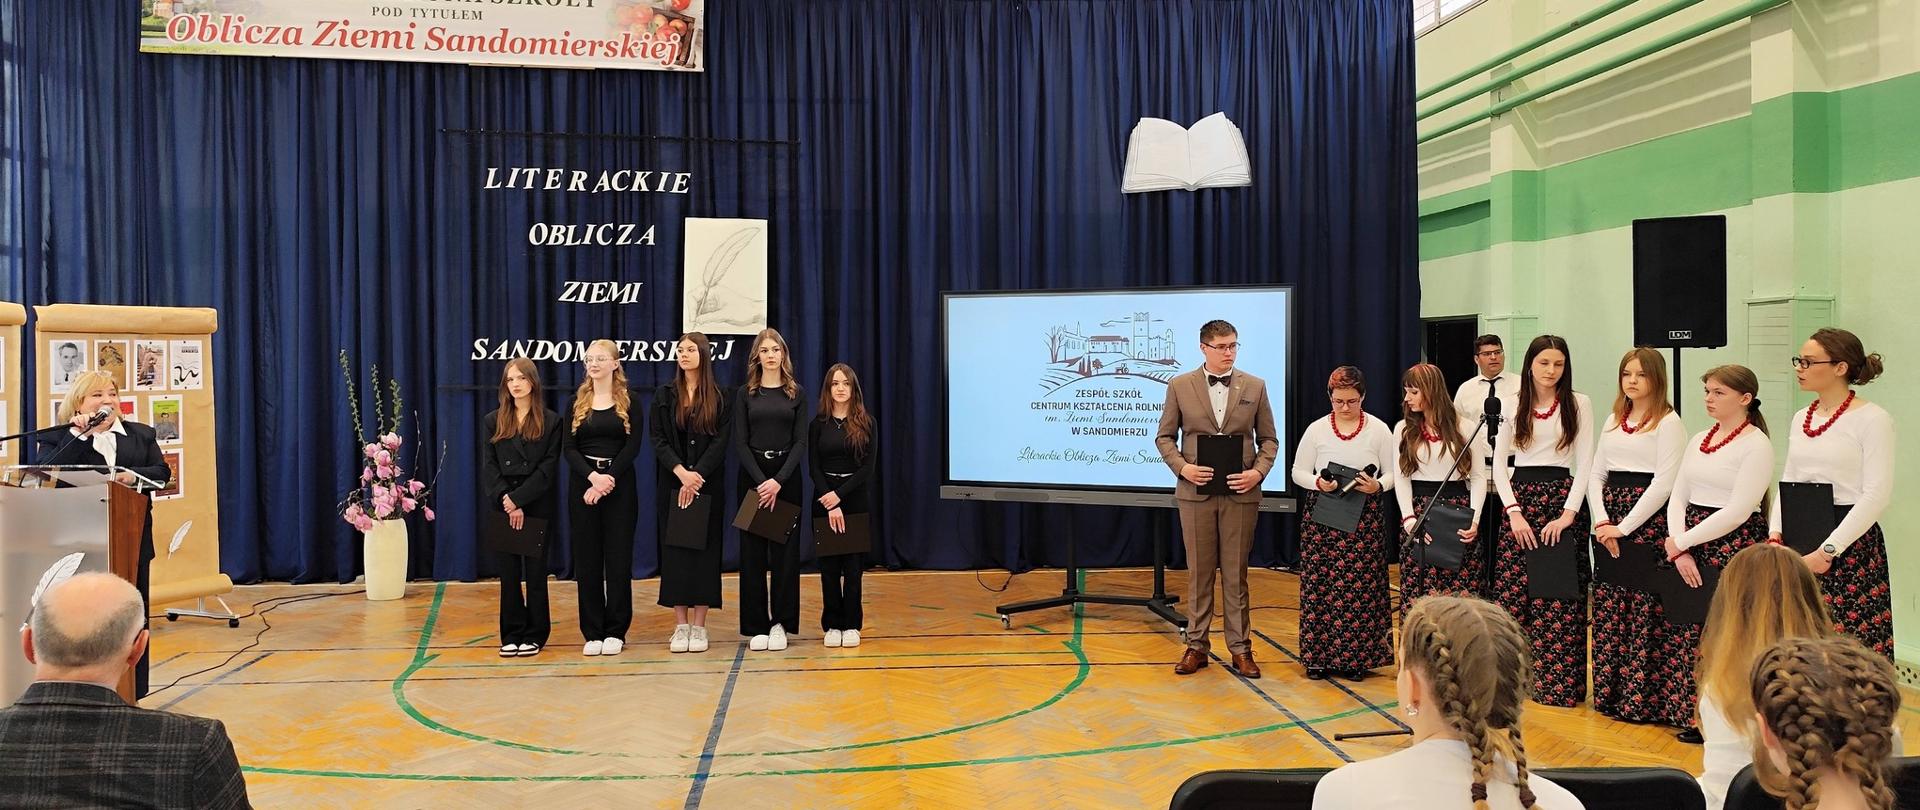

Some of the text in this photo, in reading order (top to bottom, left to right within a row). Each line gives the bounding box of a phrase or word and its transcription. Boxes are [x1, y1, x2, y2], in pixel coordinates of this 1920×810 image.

[372, 6, 483, 21] POD TYTUŁEM
[167, 14, 681, 65] Oblicza Ziemi Sandomierskiej
[484, 167, 692, 194] LITERACKIE
[529, 223, 656, 246] OBLICZA
[558, 281, 643, 304] ZIEMI
[1075, 387, 1143, 399] ZESPÓŁ SZKÓŁ
[1031, 401, 1072, 411] CENTRUM
[1073, 402, 1133, 412] KSZTAŁCENIA
[1071, 426, 1148, 437] W SANDOMIERZU
